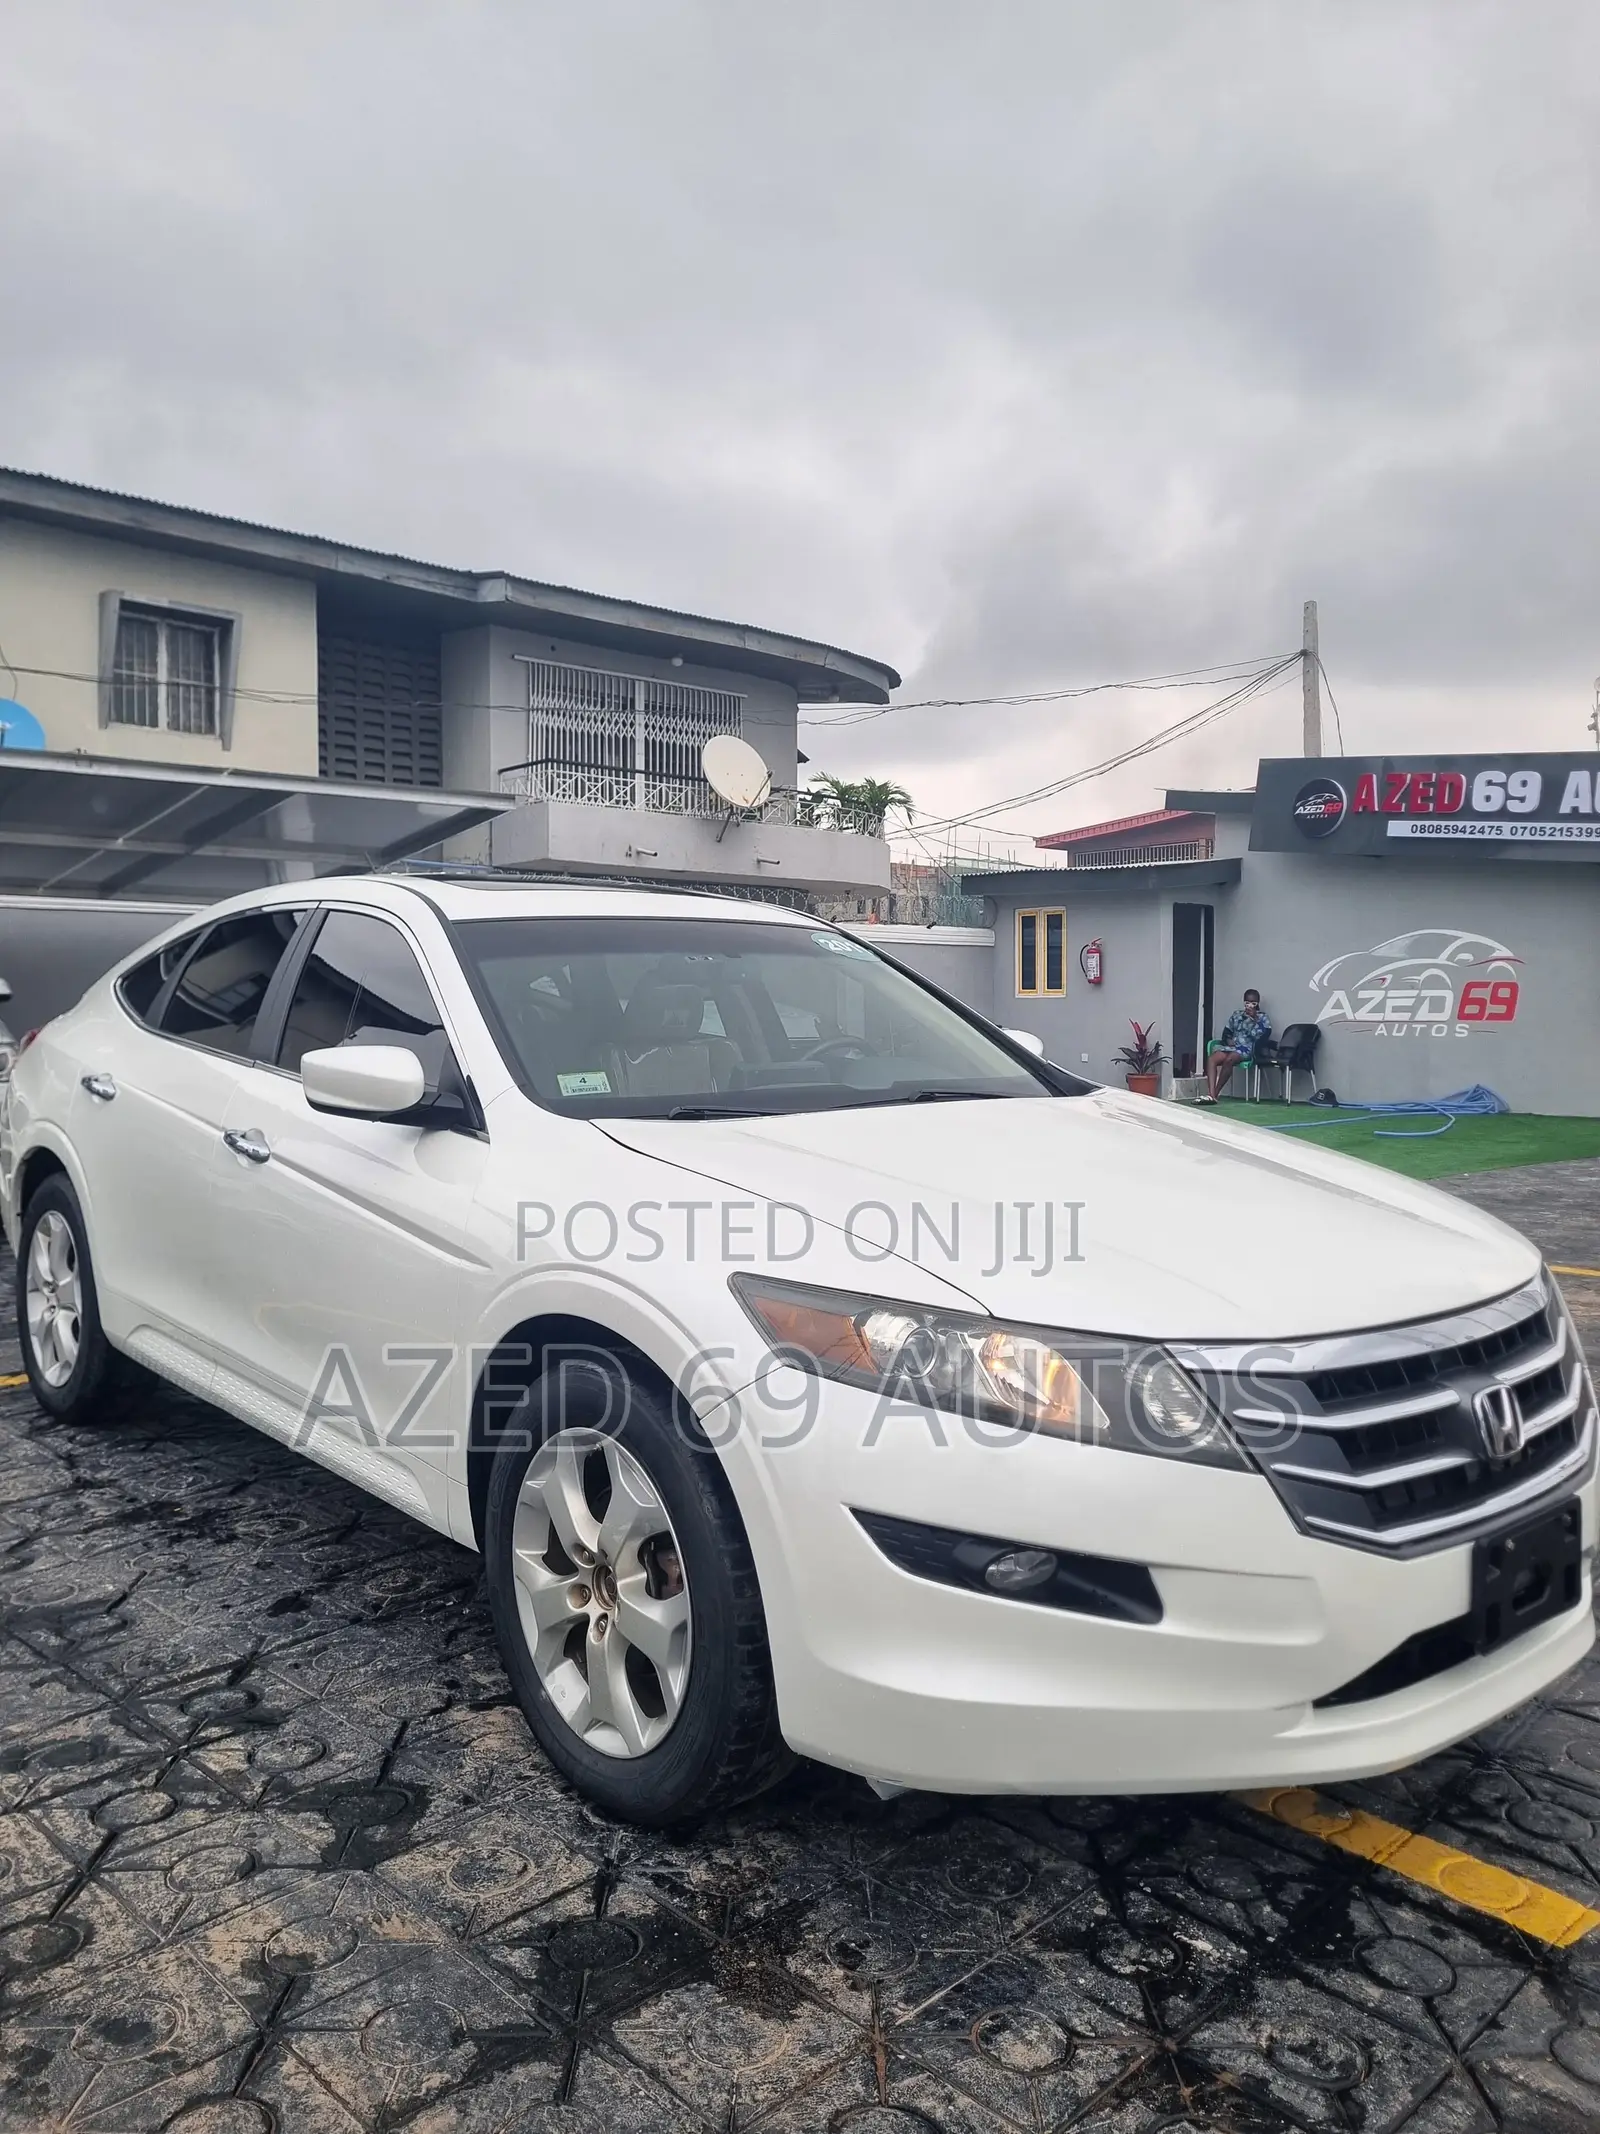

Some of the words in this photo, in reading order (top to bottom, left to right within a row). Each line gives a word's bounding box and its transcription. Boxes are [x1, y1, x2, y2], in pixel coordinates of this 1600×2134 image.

[1559, 770, 1600, 814] A
[1410, 823, 1504, 836] 08085942475
[1374, 1023, 1470, 1038] AUTOS
